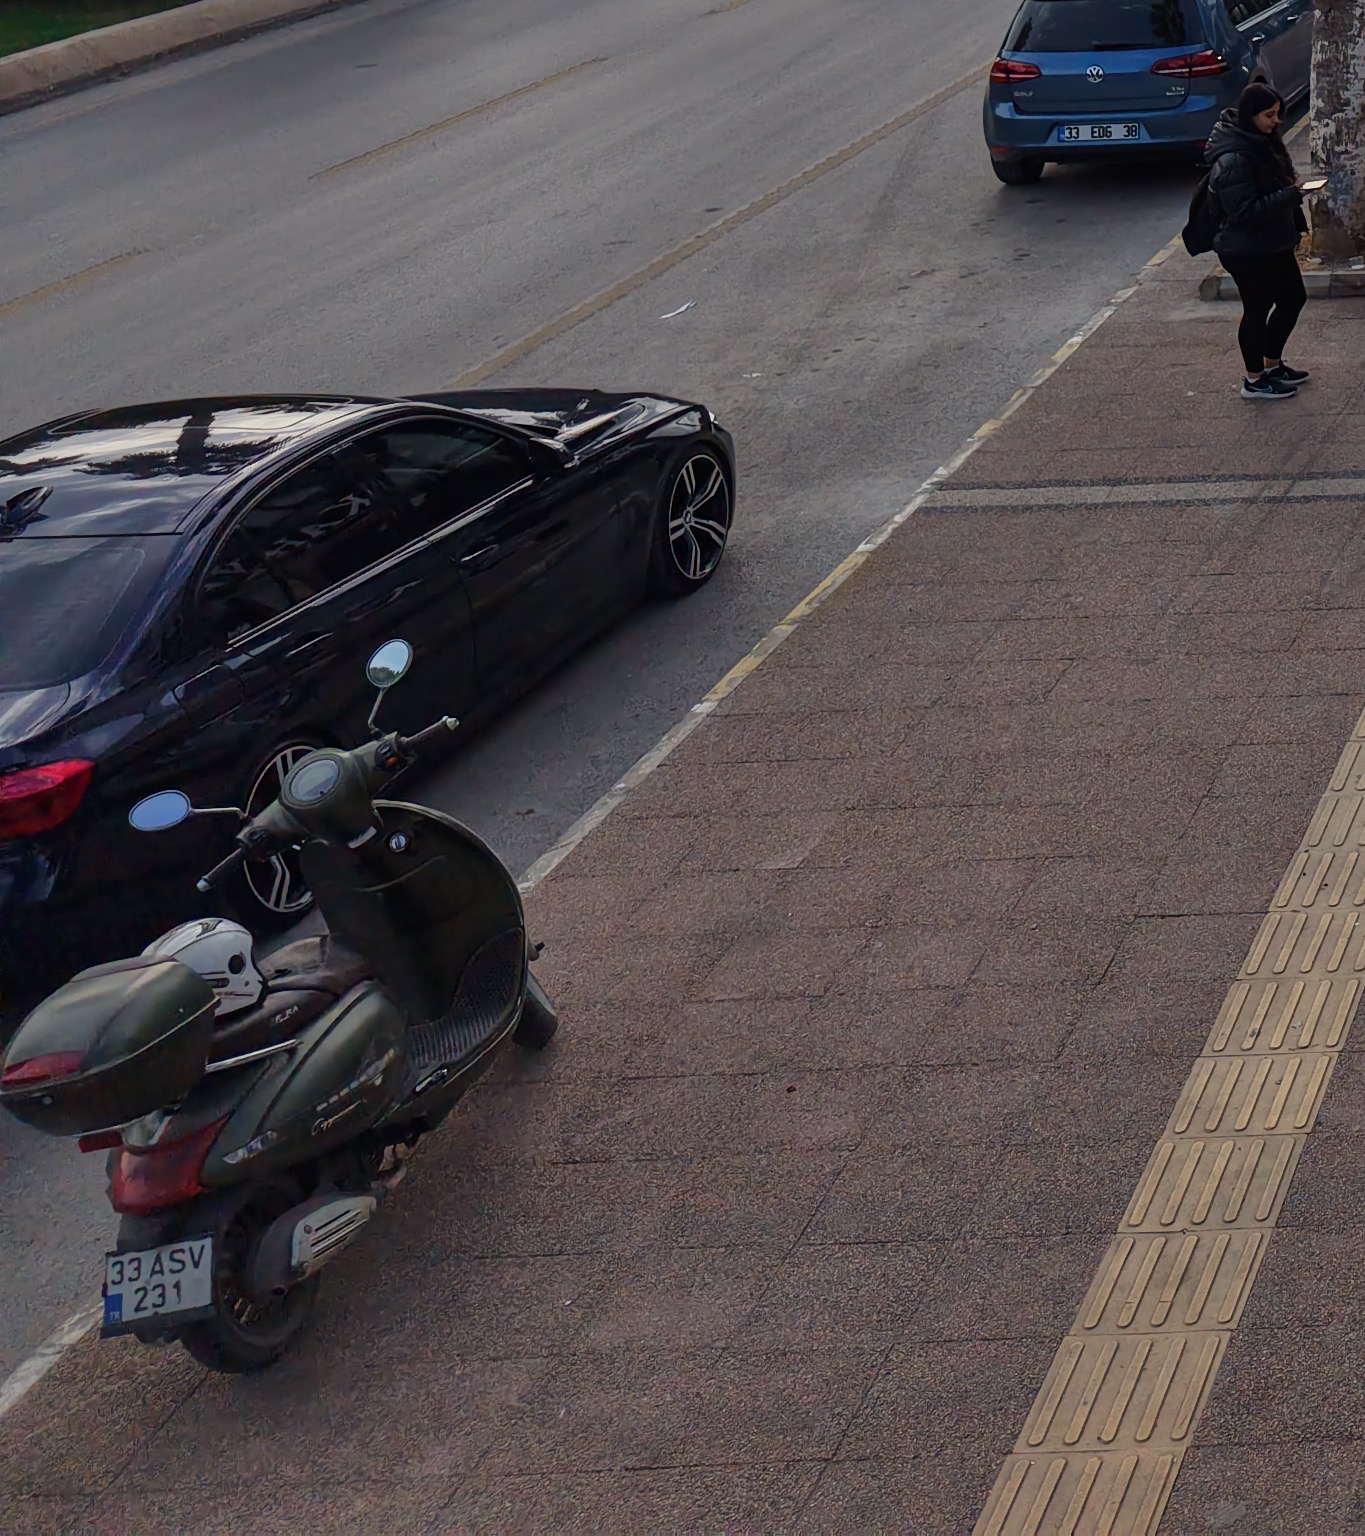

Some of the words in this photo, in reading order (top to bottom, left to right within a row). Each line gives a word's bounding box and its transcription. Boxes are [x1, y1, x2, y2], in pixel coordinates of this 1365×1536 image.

[1065, 126, 1080, 139] 33
[1123, 125, 1138, 138] 38
[110, 1256, 142, 1286] 33
[149, 1244, 205, 1279] ASV
[109, 1311, 120, 1321] TR
[133, 1279, 182, 1313] 231
